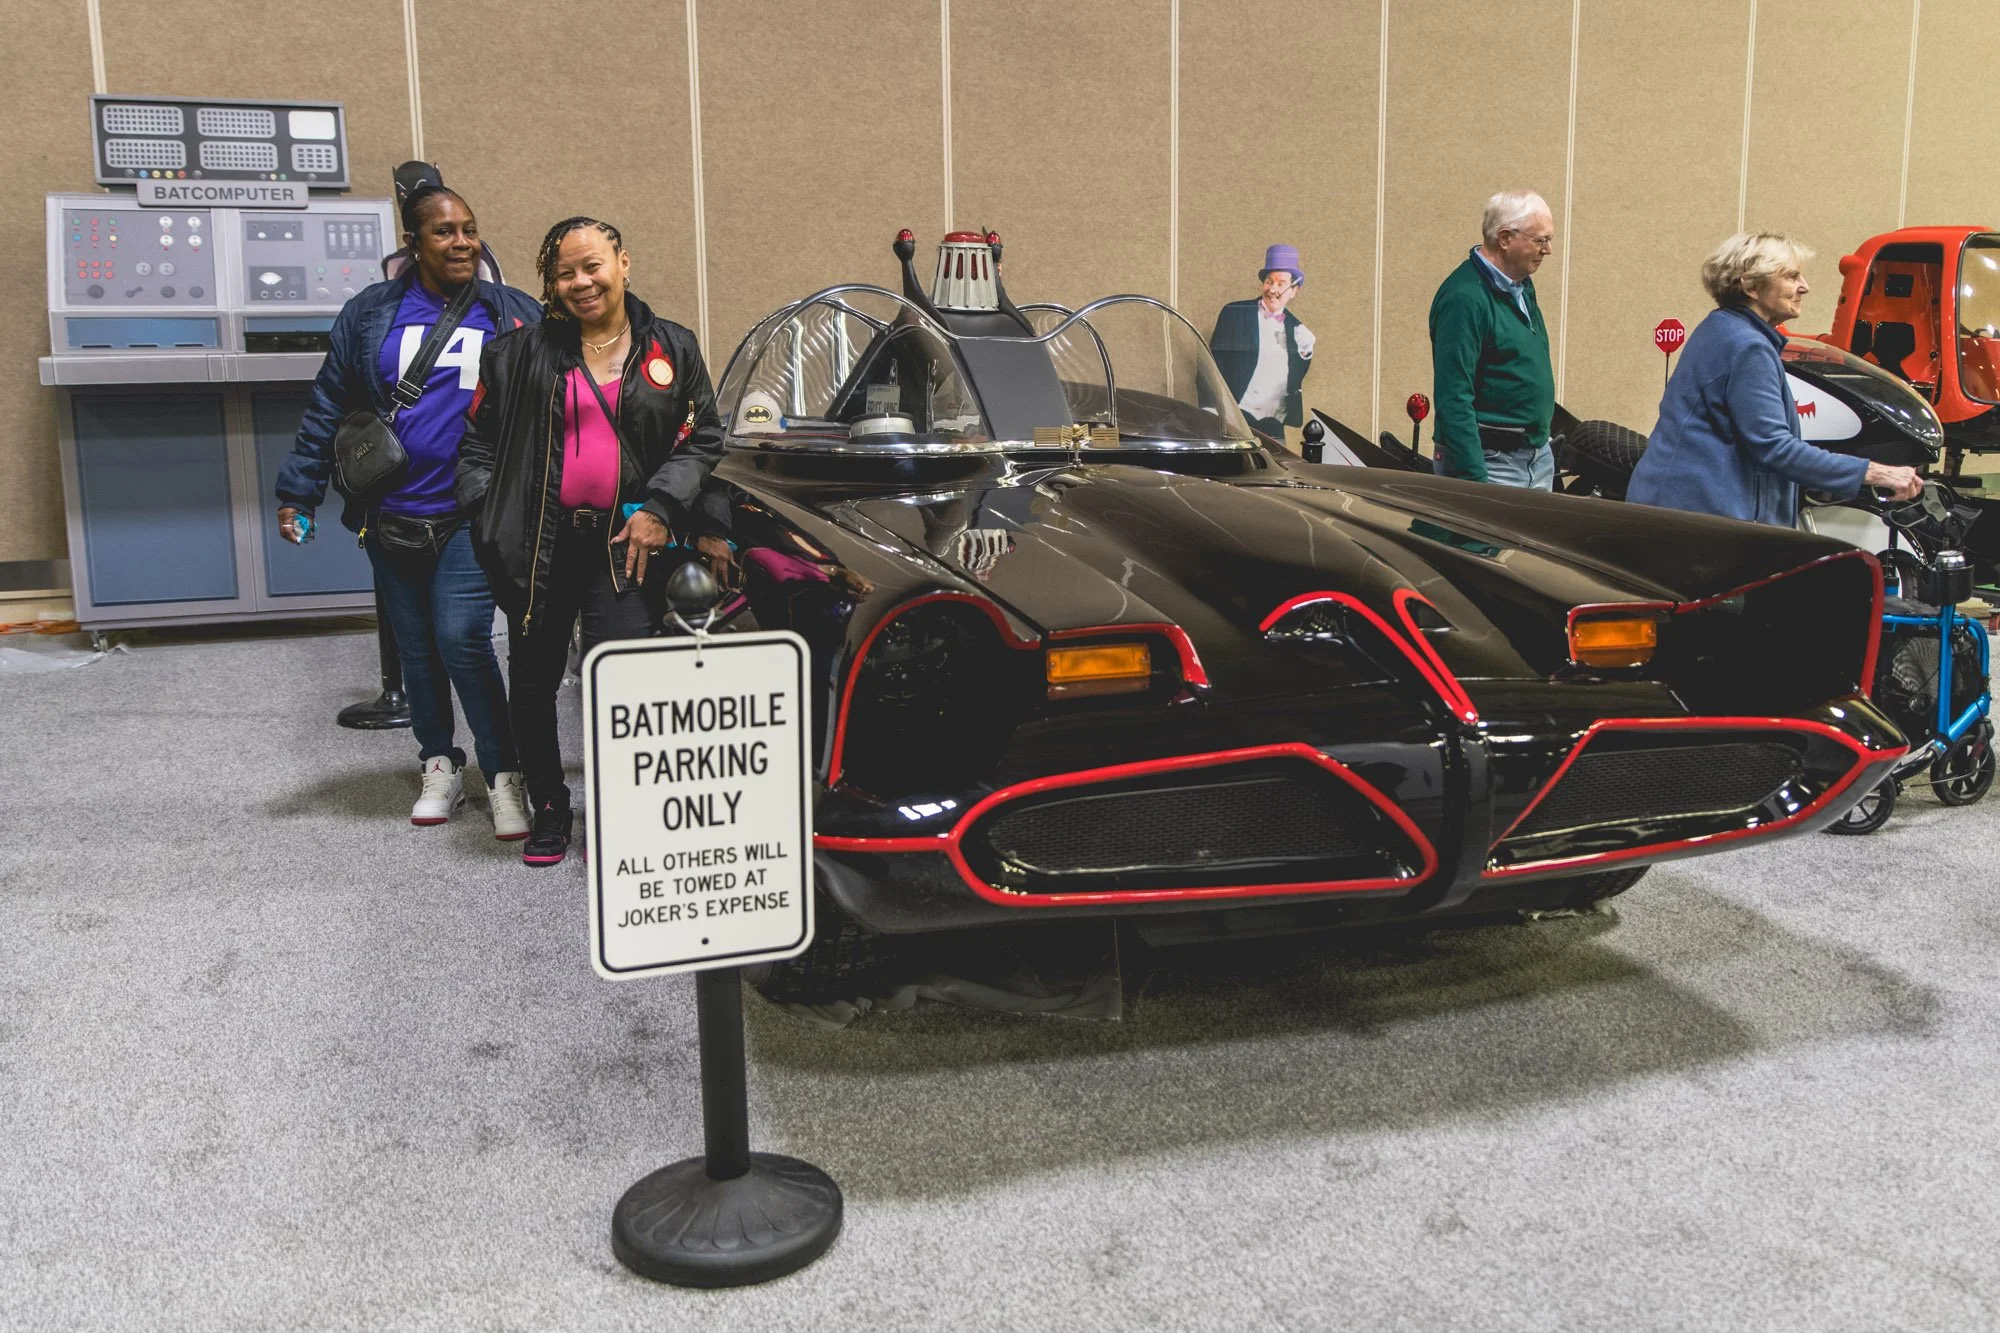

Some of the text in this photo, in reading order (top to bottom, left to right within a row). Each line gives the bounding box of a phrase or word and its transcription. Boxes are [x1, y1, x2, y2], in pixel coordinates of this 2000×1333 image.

[154, 186, 295, 201] BATCOMPUTER
[1656, 328, 1684, 342] STOP
[398, 325, 485, 390] 14
[611, 692, 787, 740] BATMOBILE
[634, 741, 768, 786] PARKING
[662, 790, 743, 831] ONLY
[616, 841, 788, 876] ALL OTHERS WILL
[639, 868, 767, 900] BE TOWED AT
[617, 891, 790, 928] JOKER'S EXPENSE
